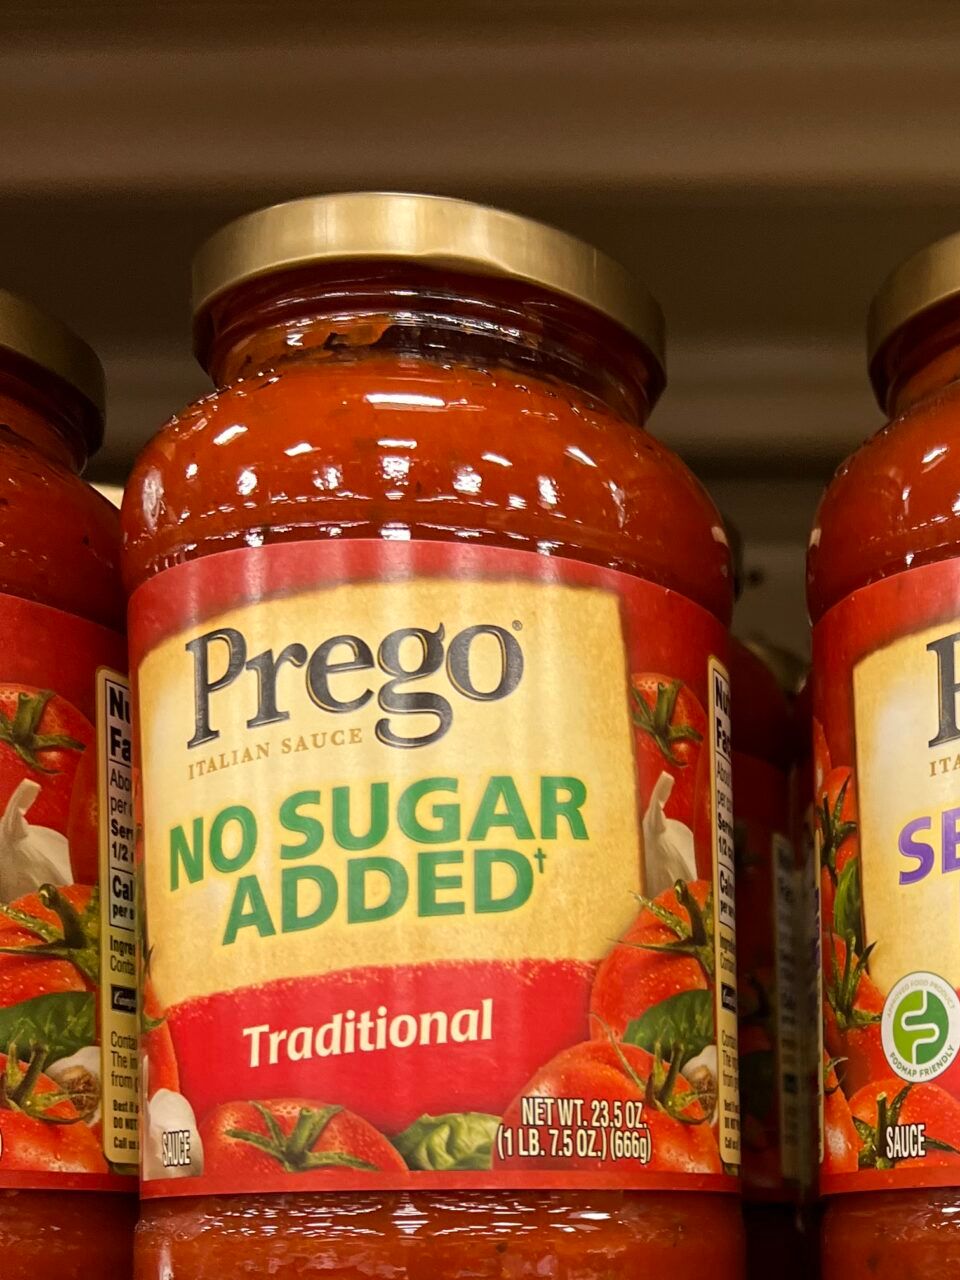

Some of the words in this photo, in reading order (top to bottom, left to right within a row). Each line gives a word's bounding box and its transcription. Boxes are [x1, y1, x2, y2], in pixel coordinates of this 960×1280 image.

[187, 743, 272, 780] ITALIAN
[281, 727, 363, 755] SAUCE
[169, 805, 258, 892] NO
[279, 776, 589, 862] SUGAR
[242, 998, 494, 1068] Traditional
[889, 1051, 918, 1077] FODMAP
[919, 1044, 955, 1077] FRIENDLY
[522, 1097, 554, 1126] NET
[557, 1098, 588, 1127] WT.
[591, 1100, 622, 1128] 23.5
[625, 1101, 647, 1129] OZ.
[161, 1130, 192, 1168] SAUCE
[497, 1124, 513, 1160] (1
[518, 1128, 545, 1156] LB.
[549, 1129, 573, 1157] 7.5
[576, 1127, 607, 1161] OZ.)
[610, 1127, 652, 1164] (666g)
[886, 1123, 926, 1159] SAUCE
